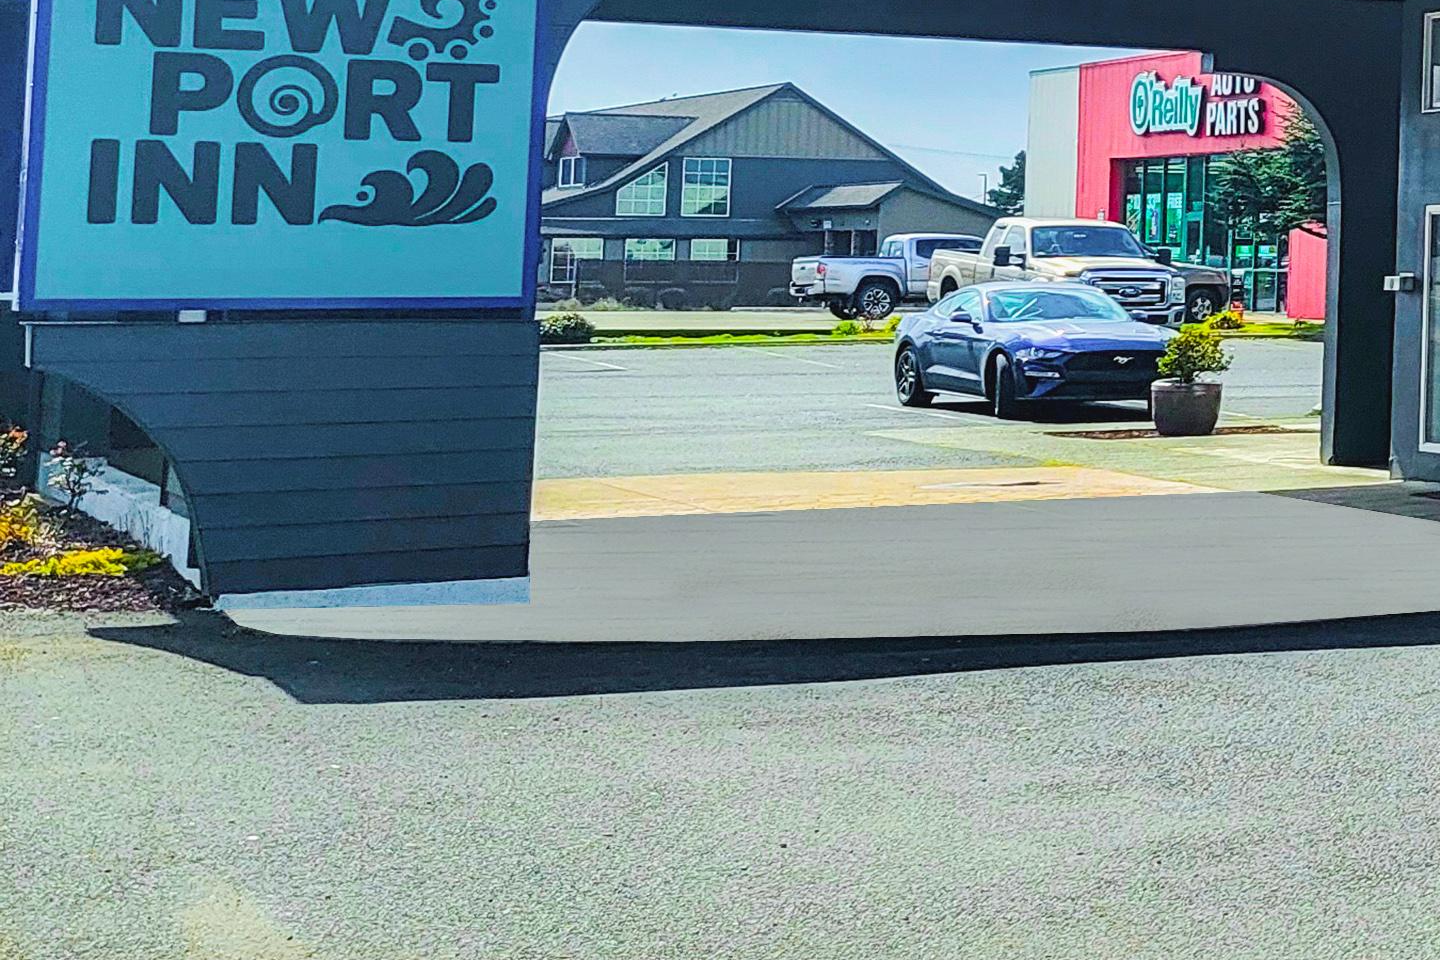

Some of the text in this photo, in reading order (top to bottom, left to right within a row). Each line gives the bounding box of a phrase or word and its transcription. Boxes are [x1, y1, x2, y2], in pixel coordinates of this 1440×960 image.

[149, 51, 499, 142] PORT
[1131, 75, 1259, 136] O'Reilly PARTS
[87, 139, 318, 225] INN
